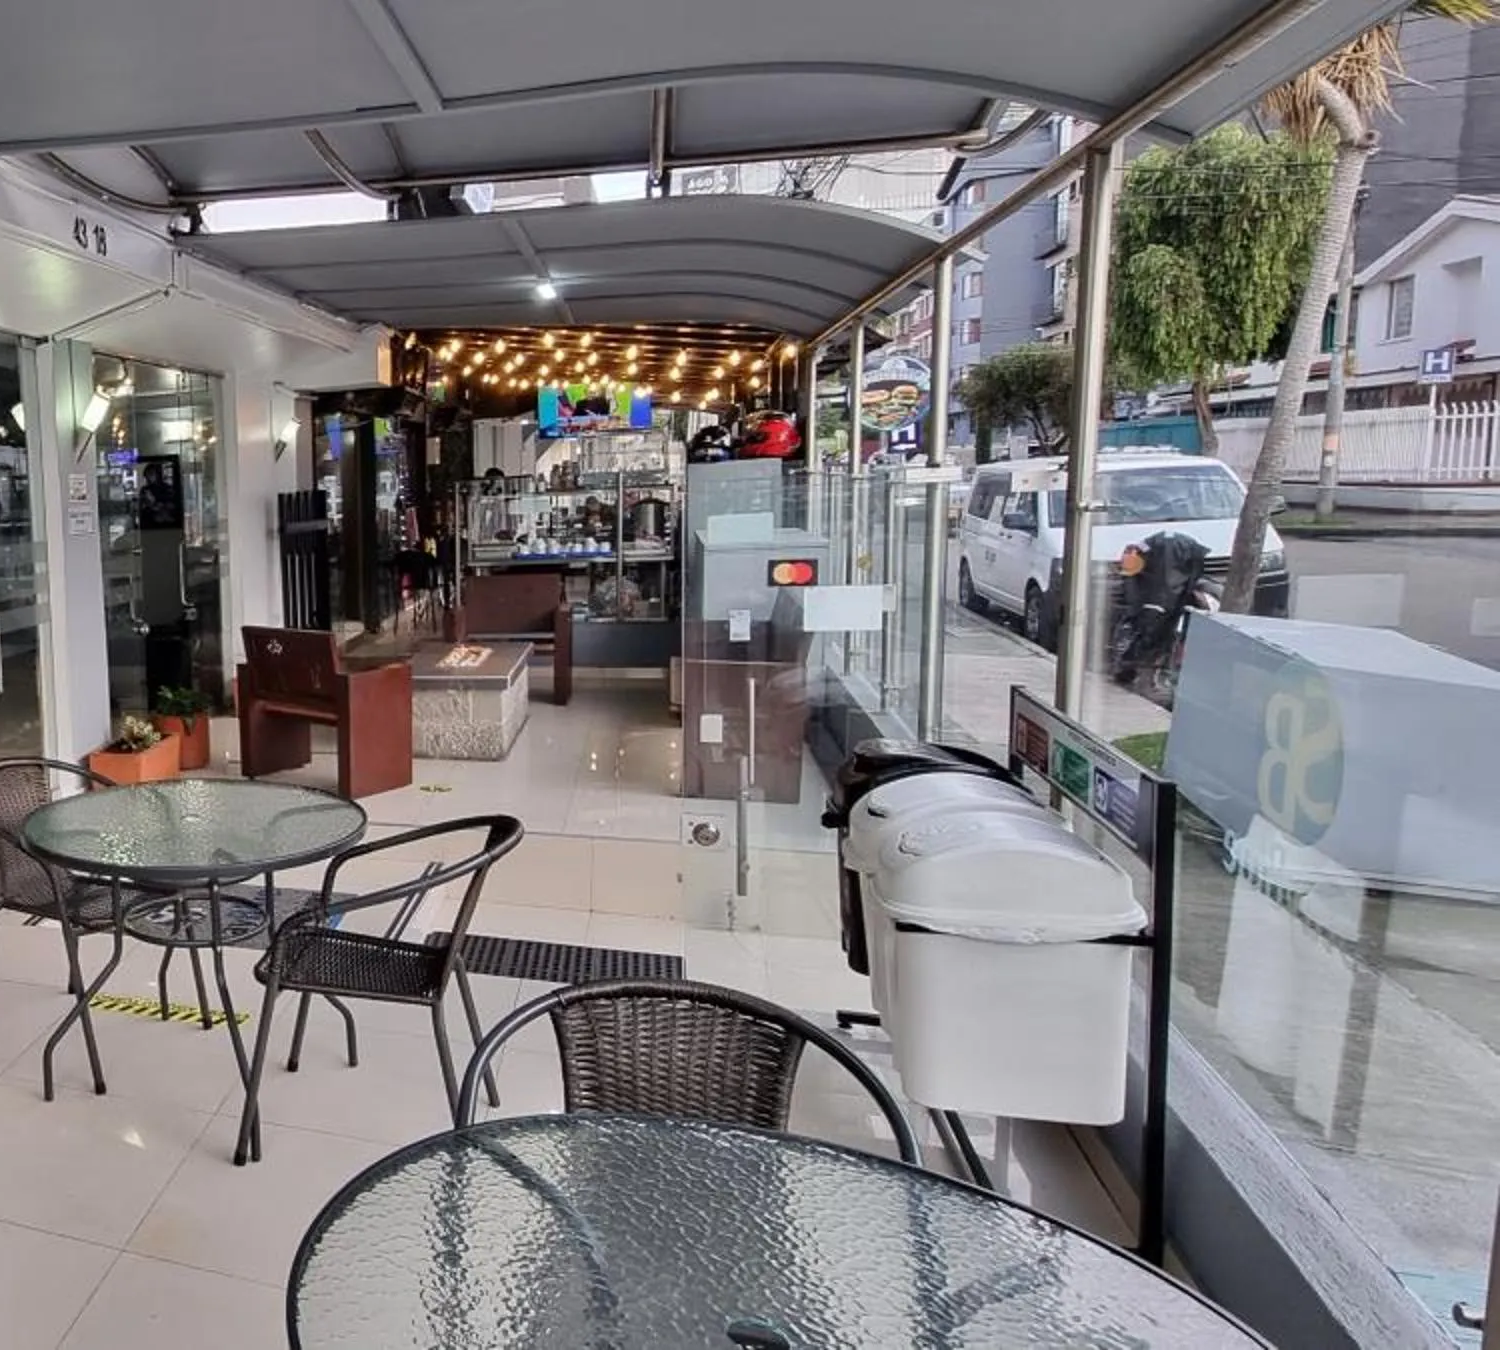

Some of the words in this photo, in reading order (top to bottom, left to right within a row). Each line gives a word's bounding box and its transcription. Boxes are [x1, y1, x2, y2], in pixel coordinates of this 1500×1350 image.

[73, 215, 89, 250] 43
[92, 223, 107, 257] 18
[1425, 351, 1450, 373] H
